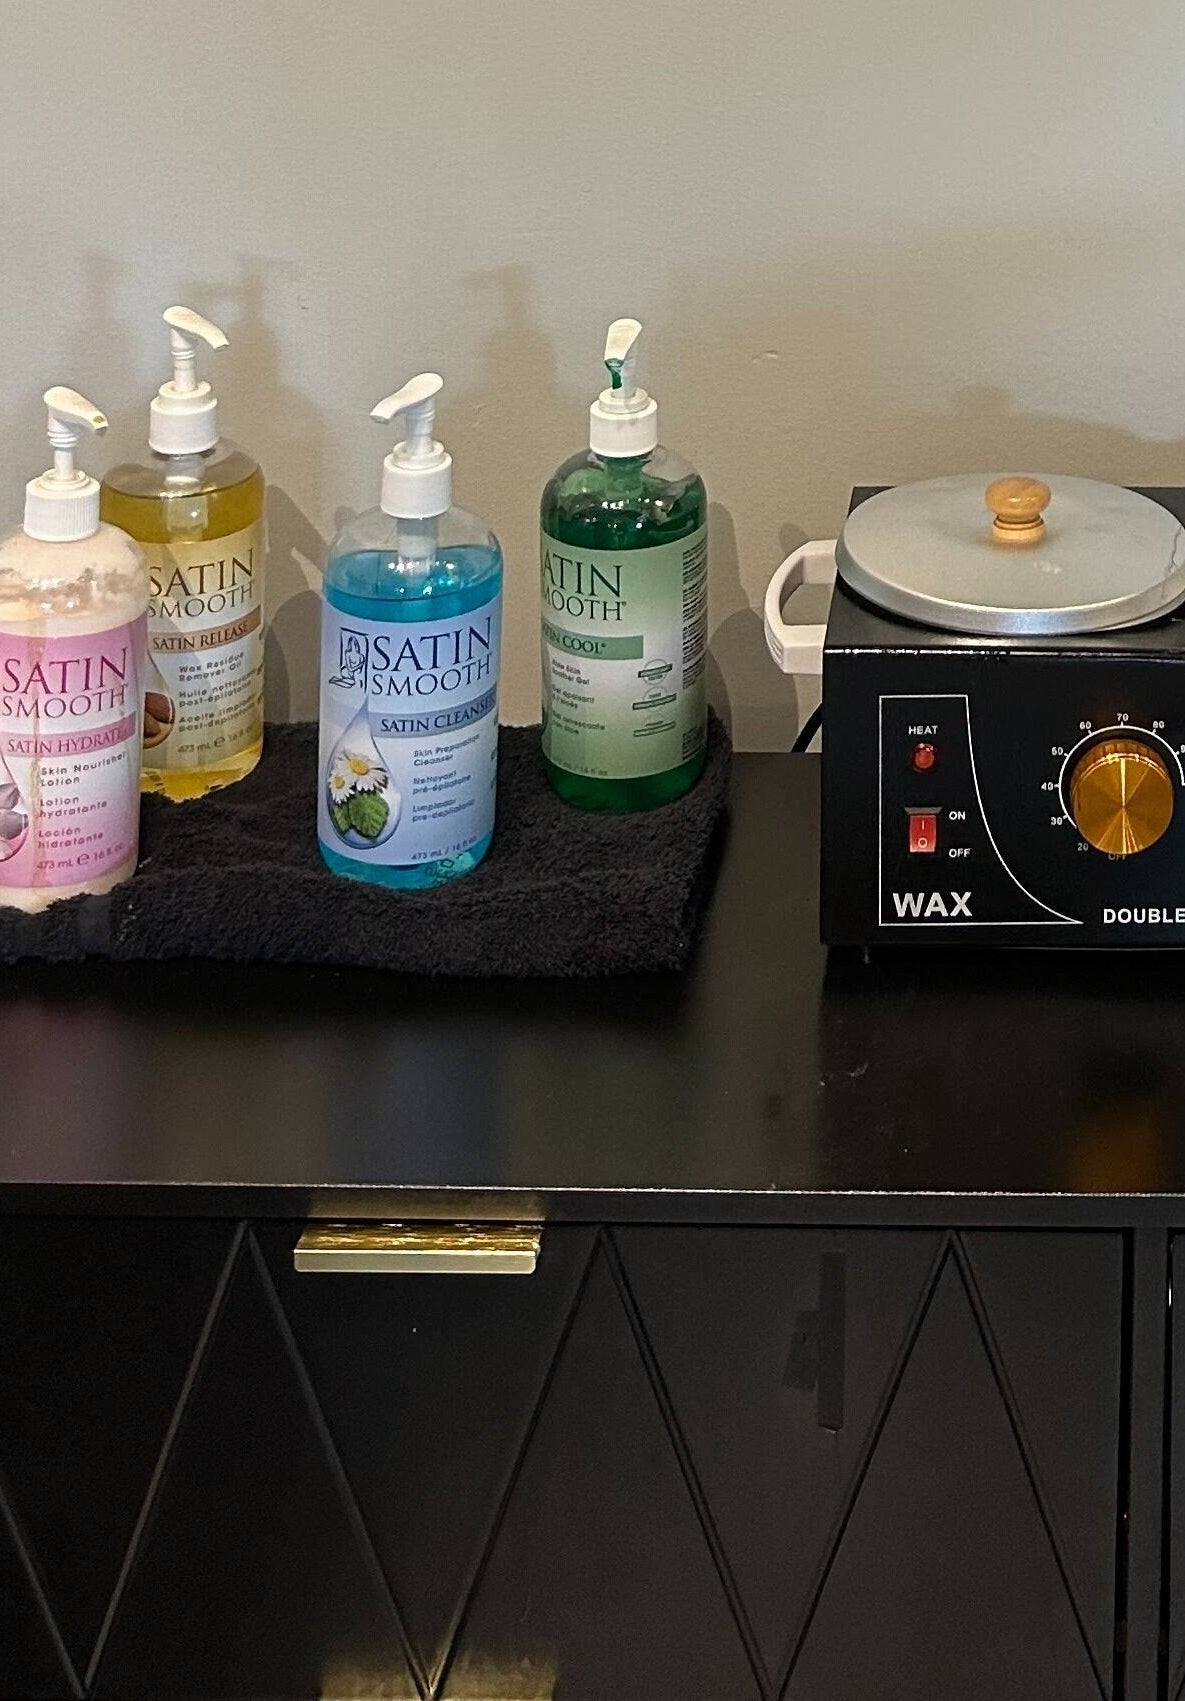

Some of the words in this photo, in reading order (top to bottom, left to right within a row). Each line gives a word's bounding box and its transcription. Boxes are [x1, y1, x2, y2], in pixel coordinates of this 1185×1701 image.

[149, 547, 254, 597] SATIN
[542, 548, 623, 598] ATIN
[153, 637, 195, 650] SATIN
[371, 616, 491, 672] SATIN
[2, 647, 128, 694] SATIN
[371, 652, 490, 696] SMOOTH
[1, 684, 126, 719] SMOOTH
[1117, 713, 1129, 721] 70
[380, 717, 430, 733] SATIN
[908, 725, 938, 735] HEAT
[8, 738, 52, 754] SATIN
[40, 767, 68, 776] Skin
[41, 776, 80, 787] Lotion
[1041, 782, 1053, 791] 40
[40, 796, 79, 807] Lotion
[948, 810, 966, 821] ON
[1051, 816, 1063, 826] 30
[1077, 842, 1089, 851] 20
[948, 848, 971, 858] OFF
[893, 892, 973, 917] WAX
